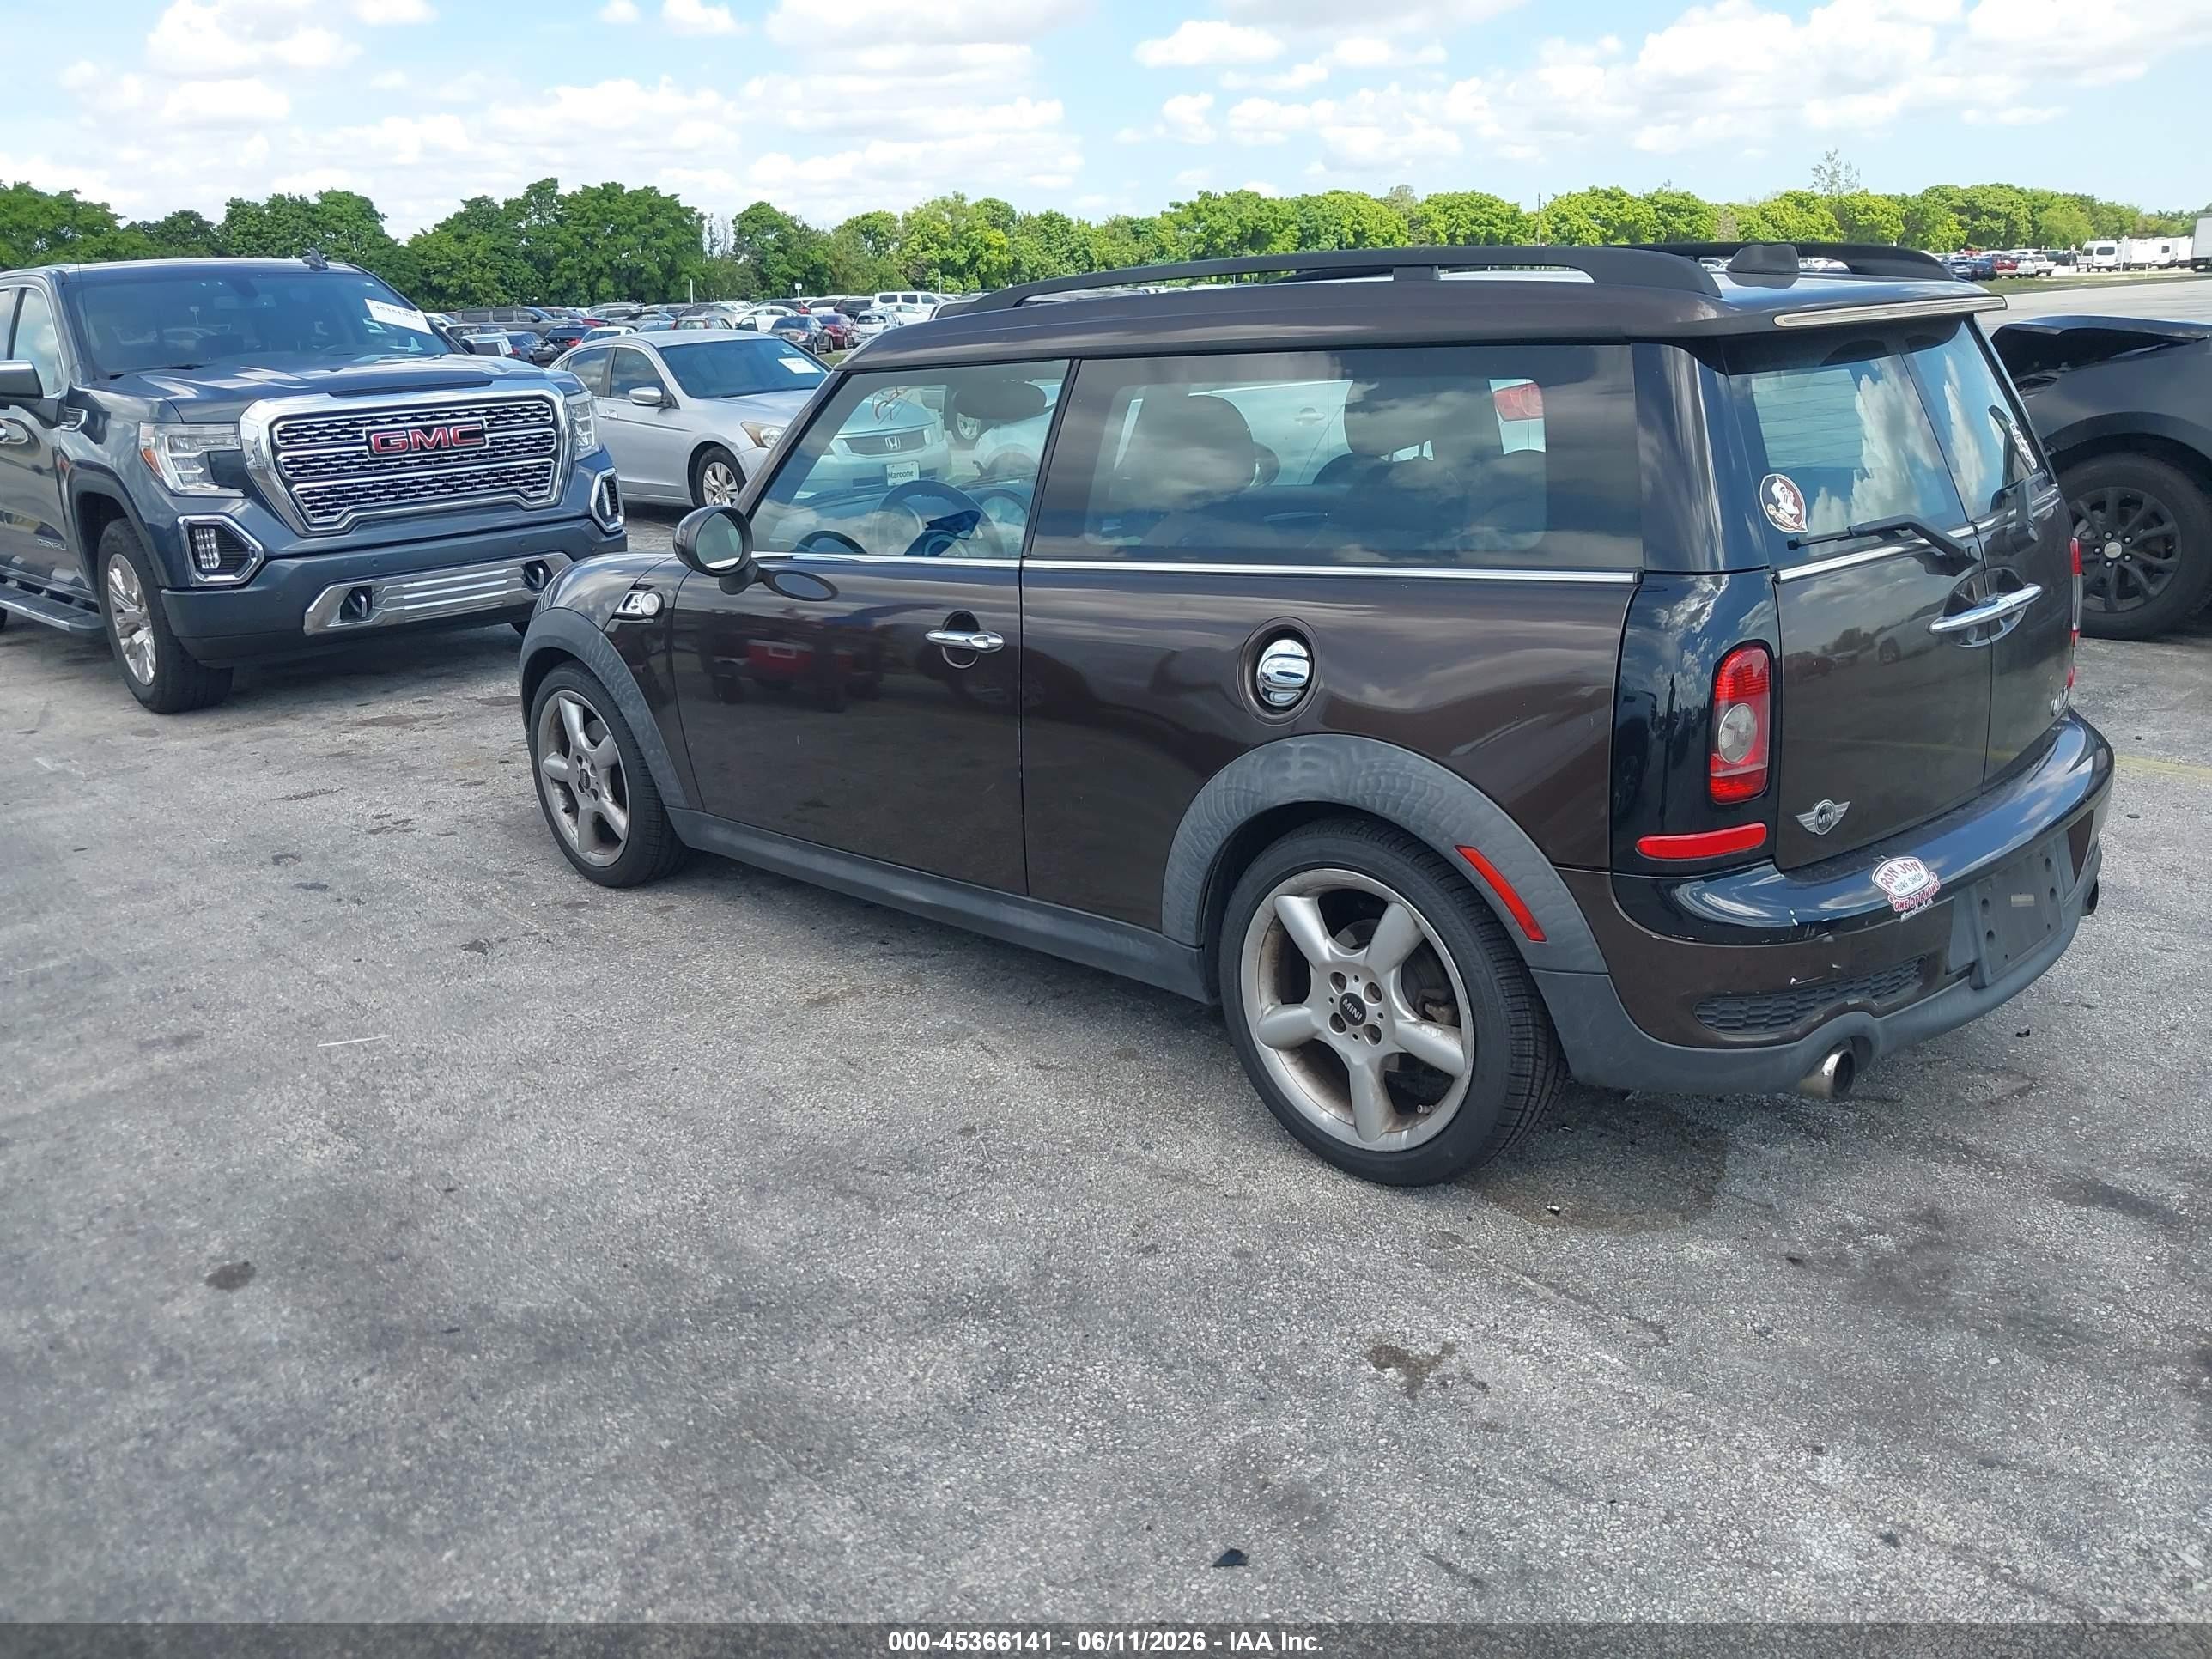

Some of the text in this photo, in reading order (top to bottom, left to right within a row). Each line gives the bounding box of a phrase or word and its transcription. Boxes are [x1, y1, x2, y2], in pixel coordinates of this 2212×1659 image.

[371, 423, 485, 454] GMC
[1818, 811, 1835, 824] MINI
[1880, 860, 1922, 890] RON JON
[1894, 872, 1923, 892] SURF SHOP
[1894, 898, 1909, 911] ONE
[1909, 895, 1920, 908] OF
[1342, 998, 1363, 1021] MINI
